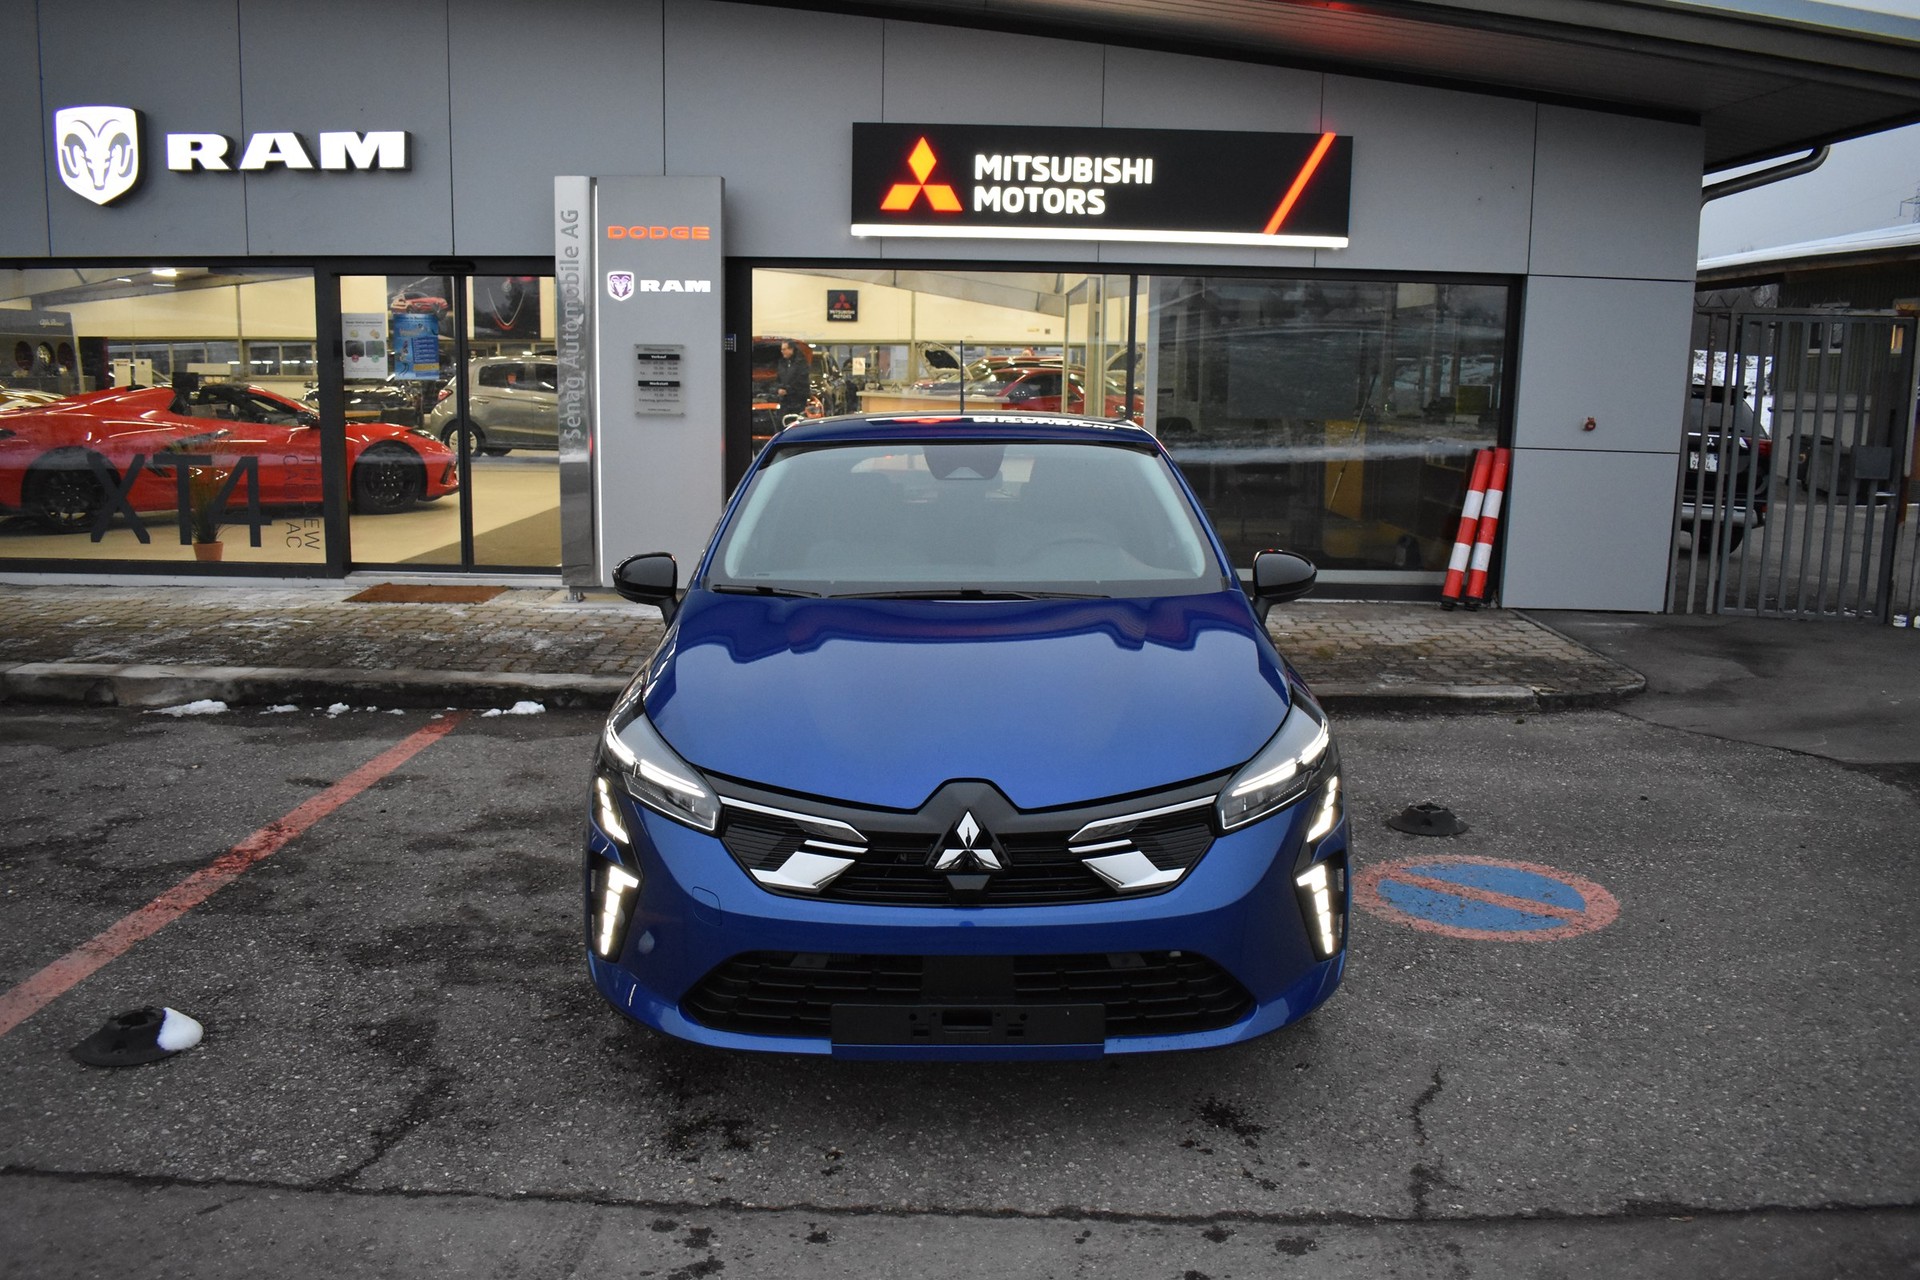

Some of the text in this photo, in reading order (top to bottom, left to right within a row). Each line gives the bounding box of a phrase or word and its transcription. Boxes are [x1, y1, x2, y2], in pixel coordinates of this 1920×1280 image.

[168, 132, 404, 169] RAM
[975, 154, 1153, 184] MITSUBISHI
[974, 186, 1105, 215] MOTORS
[608, 226, 710, 240] DODGE
[640, 280, 711, 292] RAM
[560, 209, 581, 441] Senag Automobile AG
[87, 452, 273, 548] XT4
